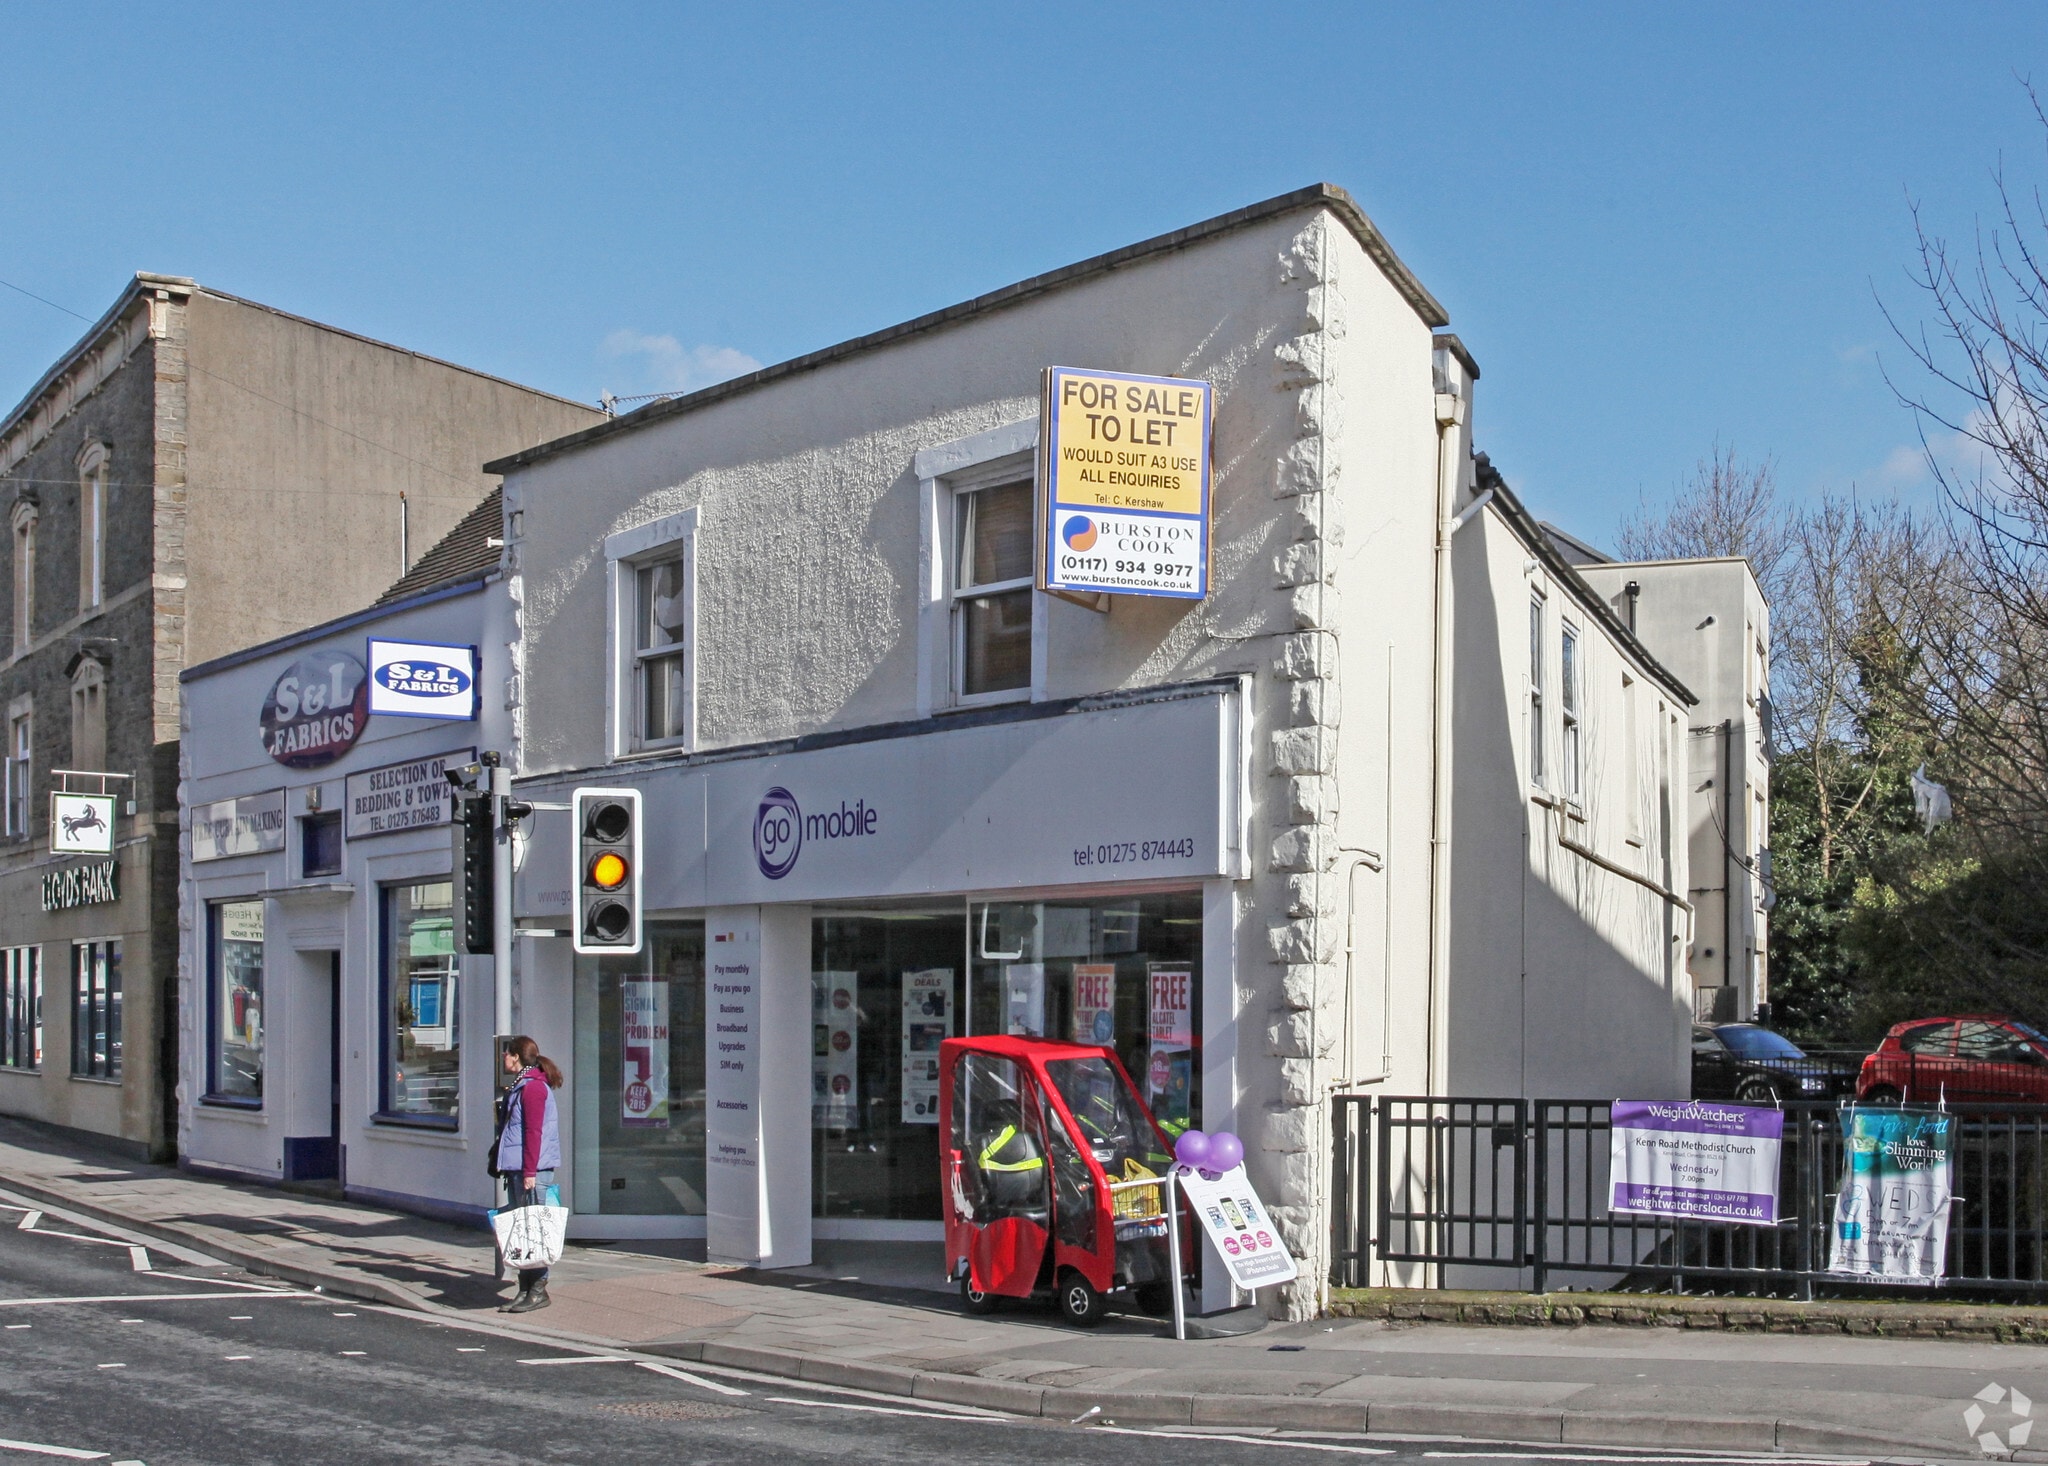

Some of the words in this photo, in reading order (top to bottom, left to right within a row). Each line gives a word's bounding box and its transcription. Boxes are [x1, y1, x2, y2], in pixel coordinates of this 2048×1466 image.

[1064, 380, 1118, 410] FOR
[1125, 386, 1202, 419] SALE/
[1086, 414, 1121, 442] TO
[1130, 418, 1178, 447] LET
[1063, 447, 1113, 464] WOULD
[1117, 452, 1147, 467] SUIT
[1151, 455, 1167, 469] A3
[1171, 457, 1197, 472] USE
[1079, 469, 1104, 484] ALL
[1109, 471, 1181, 490] ENQUIRIES
[1095, 493, 1111, 505] Tel:
[1113, 495, 1123, 505] C.
[1125, 496, 1164, 509] Kershaw
[1101, 521, 1194, 541] BURSTON
[1118, 538, 1175, 554] COOK
[1061, 555, 1108, 572] (0117)
[1116, 560, 1146, 574] 934
[1154, 563, 1193, 577] 9977
[1061, 573, 1193, 589] www.burstoncook.co.uk
[388, 663, 459, 684] S&L
[275, 663, 354, 722] S&L
[388, 679, 459, 694] FABRICS
[273, 713, 354, 755] FABRICS
[370, 763, 427, 791] SELECTION
[432, 759, 446, 779] OF
[355, 790, 401, 815] BEDDING
[405, 788, 413, 806] &
[250, 809, 283, 832] MAKING
[370, 816, 385, 832] TEL:
[387, 811, 408, 828] 01275
[412, 806, 440, 824] 876483
[764, 818, 790, 855] go
[806, 799, 877, 840] mobile
[1074, 845, 1094, 866] tel:
[1097, 843, 1136, 864] 01275
[1141, 838, 1194, 861] 874443
[42, 867, 80, 911] LLOYDS
[82, 860, 115, 904] BANK
[715, 964, 724, 975] Pay
[725, 964, 749, 975] monthly
[625, 983, 636, 997] NO
[713, 983, 724, 995] Pay
[725, 985, 731, 993] as
[731, 985, 742, 995] you
[743, 985, 751, 995] go
[914, 978, 941, 987] DEALS
[1077, 975, 1109, 1008] FREE
[1152, 975, 1187, 1010] FREE
[720, 1004, 744, 1013] Business
[625, 1011, 637, 1025] NO
[1152, 1011, 1176, 1025] ALCATEL
[716, 1023, 748, 1033] Broadband
[1152, 1026, 1173, 1040] TABLET
[719, 1041, 746, 1053] Upgrades
[720, 1061, 731, 1070] SIM
[731, 1061, 744, 1072] only
[630, 1085, 648, 1097] KEEP
[629, 1099, 646, 1110] 2015
[716, 1099, 748, 1110] Accessories
[1648, 1105, 1744, 1123] WeightWatchers
[1636, 1137, 1656, 1148] Kenn
[1658, 1139, 1679, 1150] Road
[1681, 1140, 1725, 1153] Methodist
[1726, 1143, 1756, 1155] Church
[1907, 1135, 1926, 1147] love
[1885, 1141, 1946, 1162] Slimming
[1670, 1163, 1719, 1176] Wednesday
[1896, 1155, 1934, 1171] World
[1681, 1174, 1705, 1183] 7.00pm
[1628, 1197, 1763, 1217] weightwatcherslocal.co.uk
[1866, 1187, 1937, 1213] WEDS
